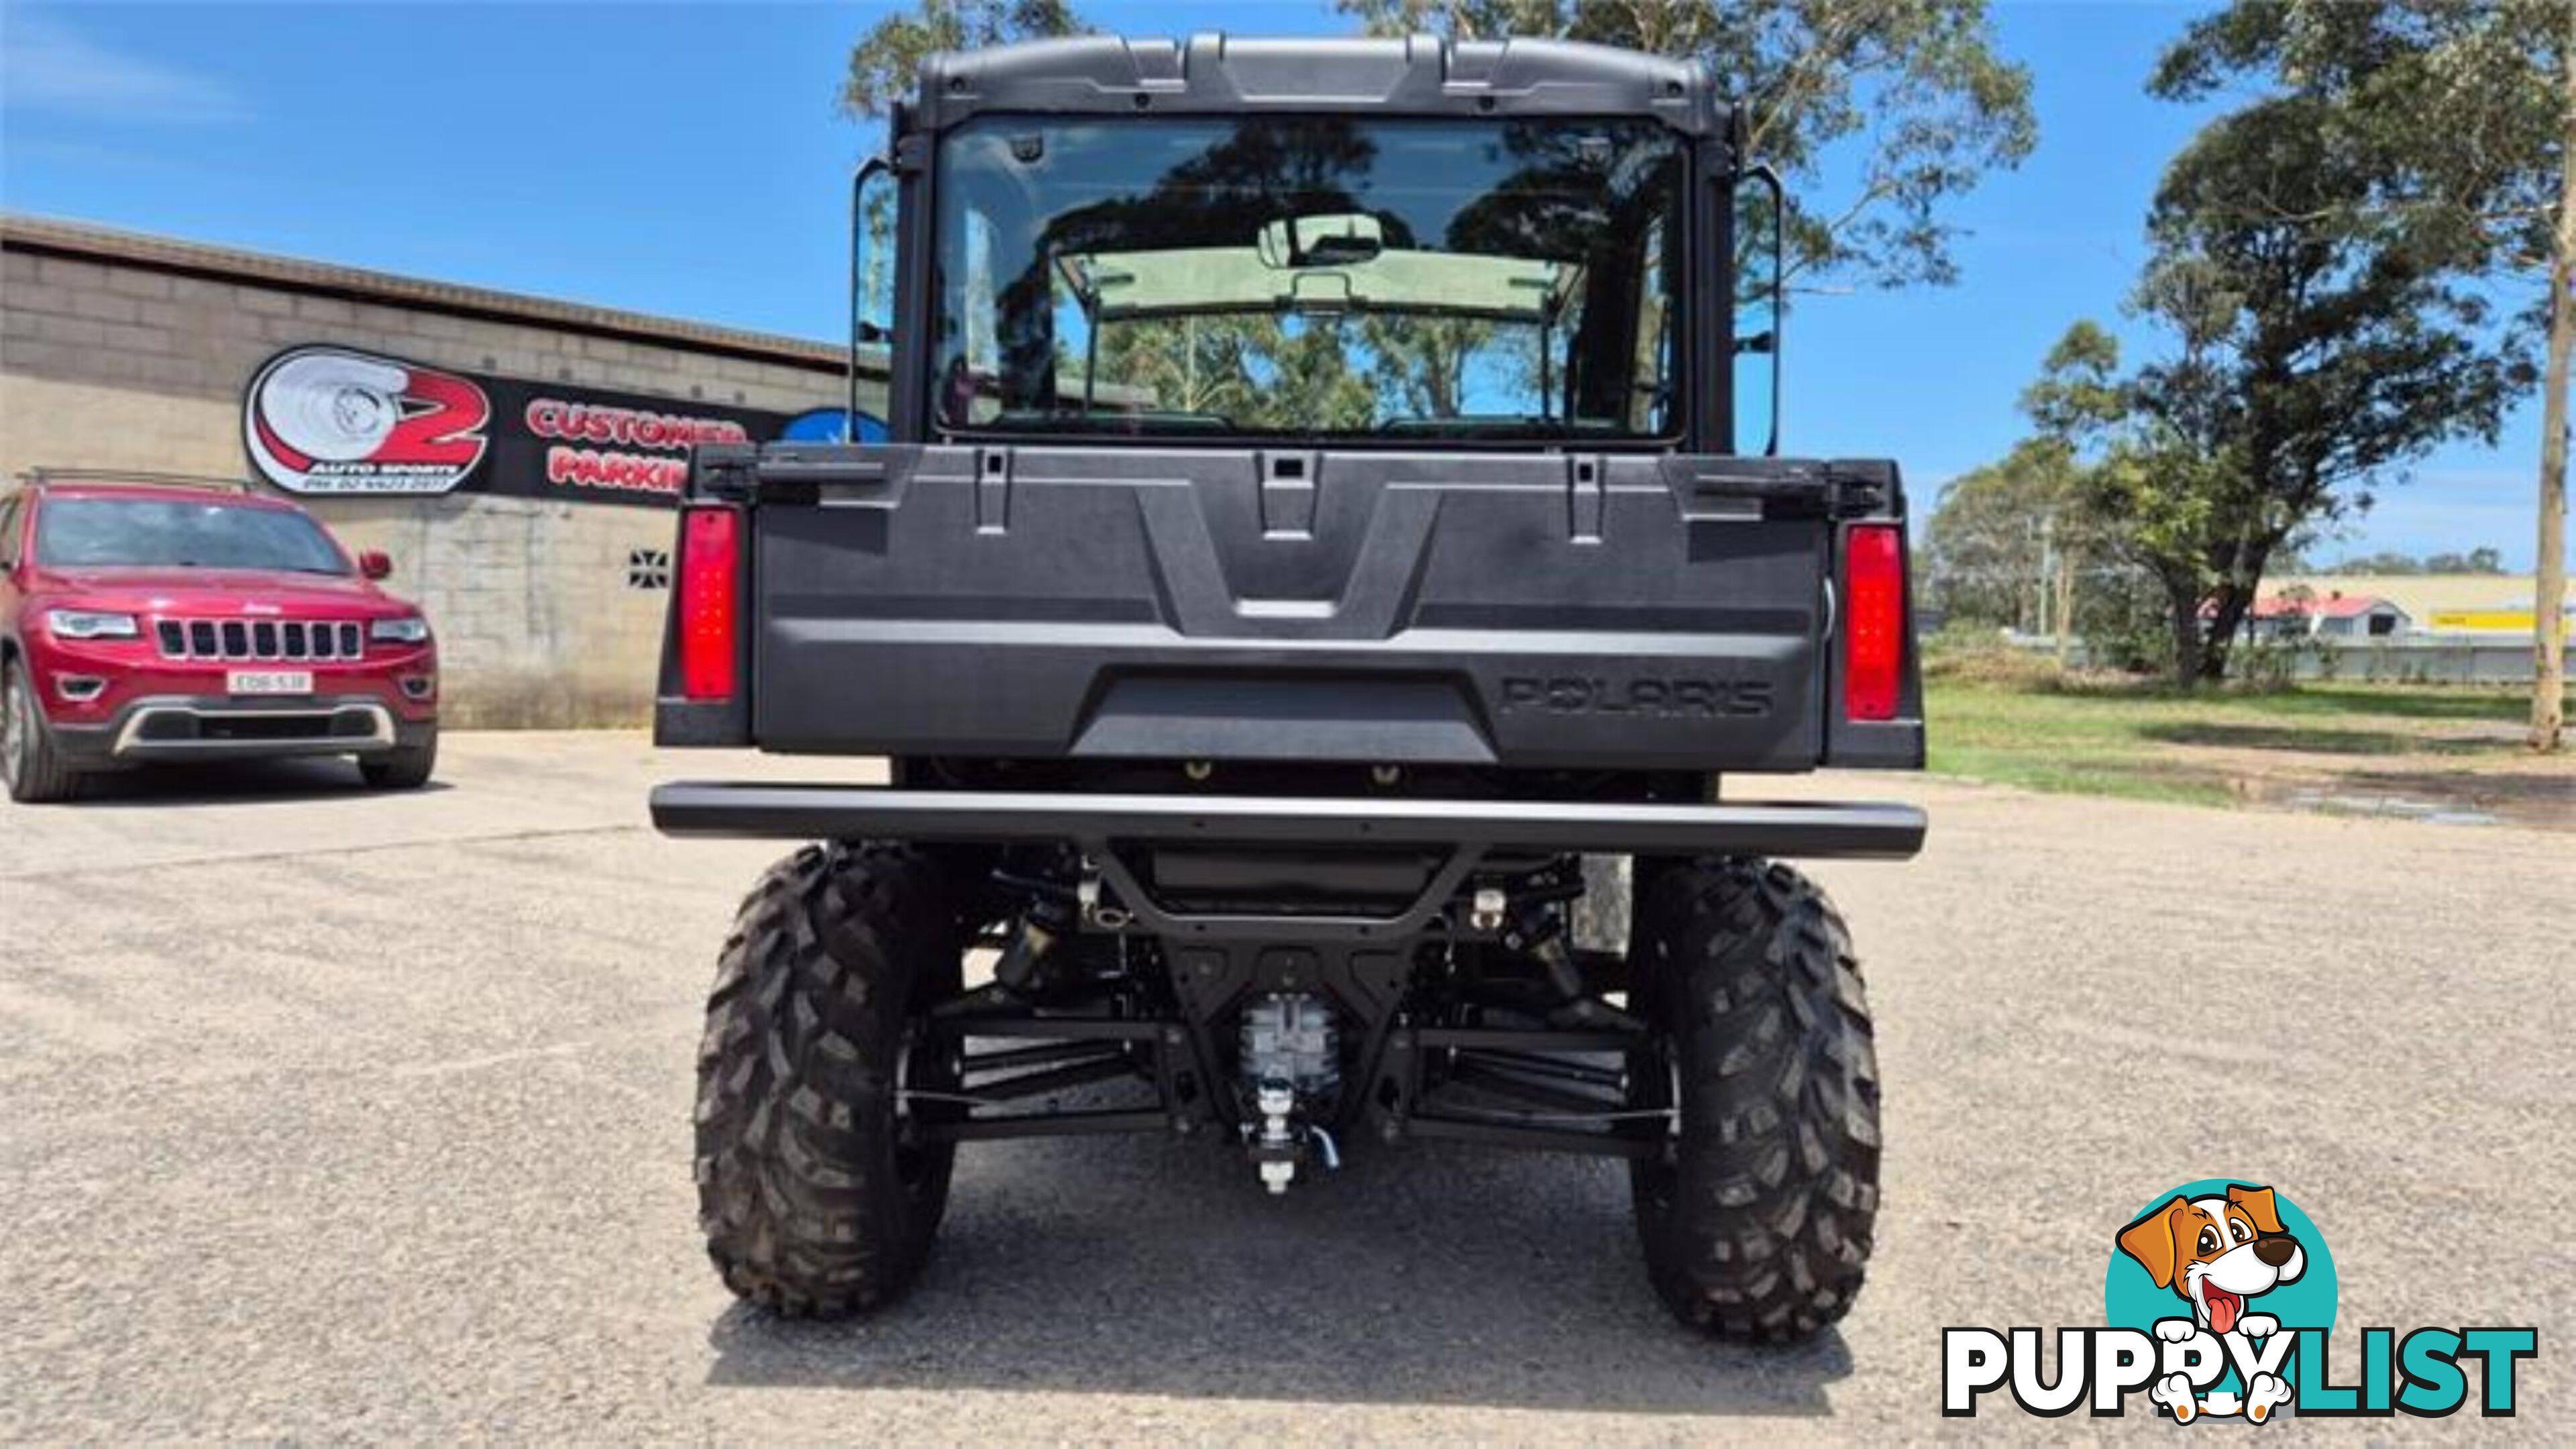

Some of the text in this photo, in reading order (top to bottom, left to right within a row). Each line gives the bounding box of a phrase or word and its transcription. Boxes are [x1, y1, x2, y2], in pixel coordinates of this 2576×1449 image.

[527, 398, 747, 449] CUSTOMER
[309, 462, 458, 475] AUTO SPORTS
[1502, 678, 1774, 716] POLARIS
